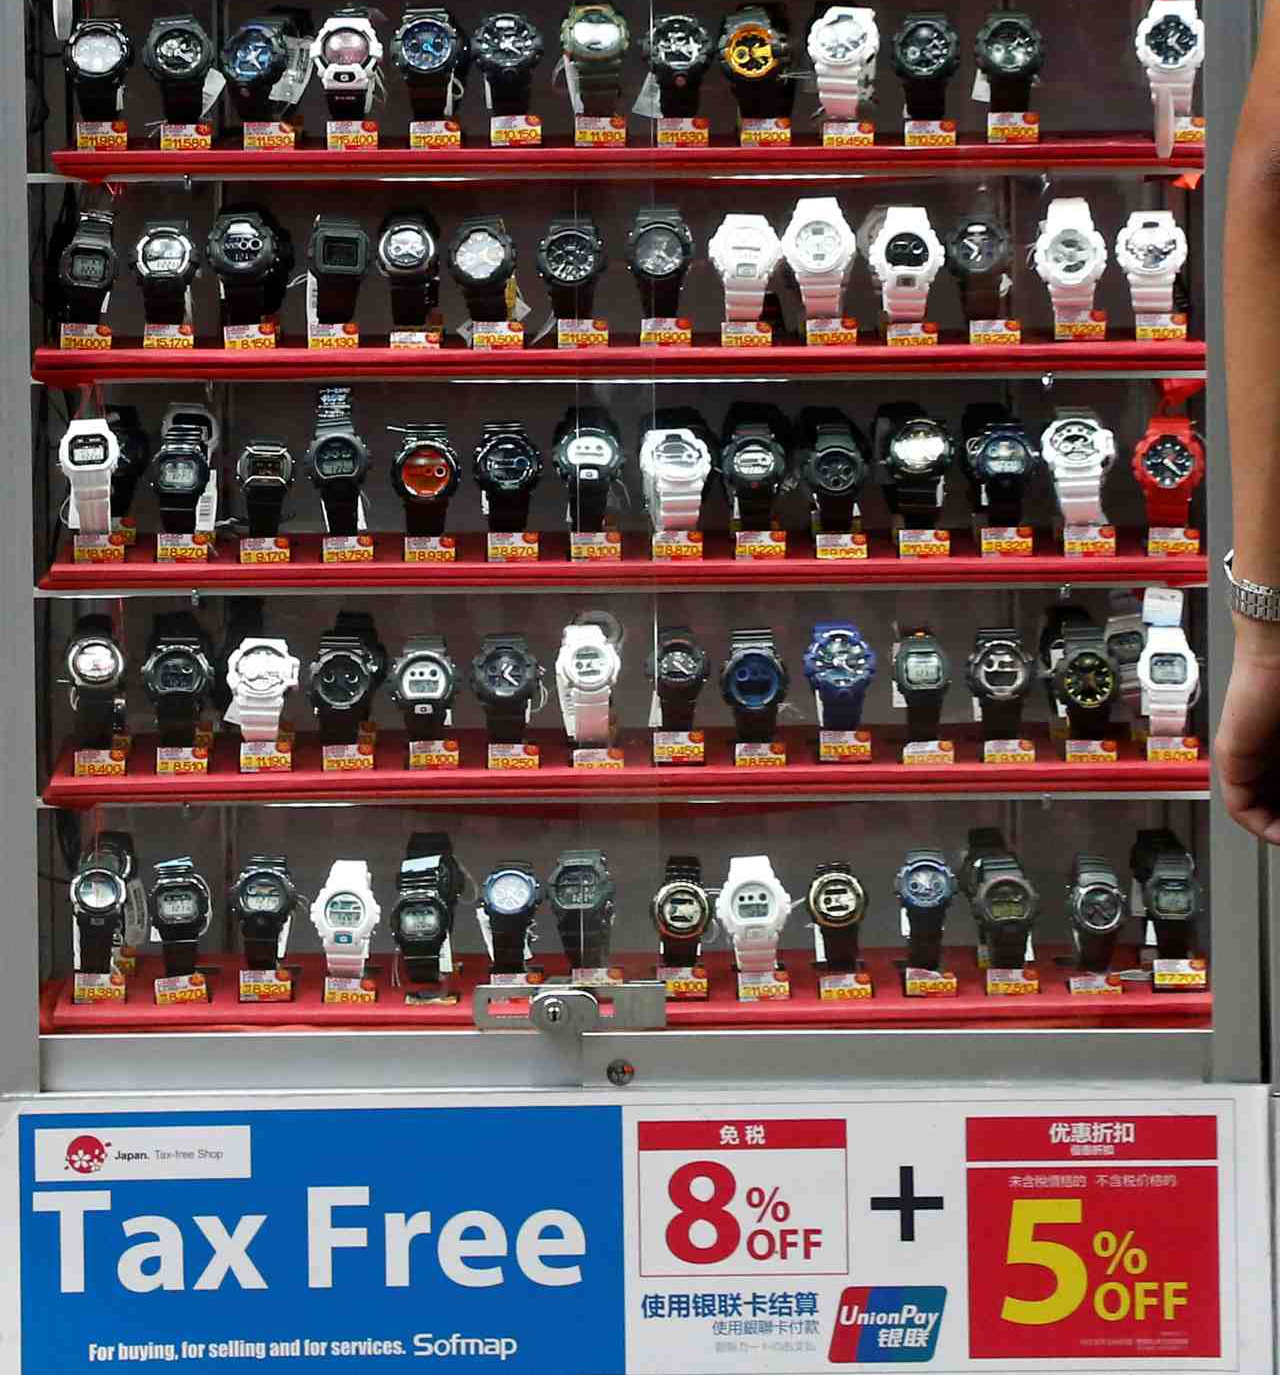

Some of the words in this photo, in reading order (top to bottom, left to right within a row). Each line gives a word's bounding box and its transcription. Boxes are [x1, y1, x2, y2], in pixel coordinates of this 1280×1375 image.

[719, 1124, 766, 1145] 免税
[1048, 1121, 1135, 1144] 优惠折扣
[197, 1148, 224, 1160] Shop
[664, 1160, 742, 1265] 8
[32, 1189, 269, 1294] Tax
[306, 1185, 586, 1289] Free
[746, 1228, 823, 1261] OFF
[1000, 1197, 1089, 1326] 5
[640, 1291, 820, 1319] 使用银联卡结算
[1092, 1281, 1189, 1322] OFF
[840, 1304, 939, 1332] UnionPay
[88, 1343, 115, 1362] For
[117, 1341, 179, 1362] buying,
[181, 1341, 206, 1359] for
[208, 1339, 266, 1360] selling
[269, 1338, 301, 1357] and
[303, 1338, 328, 1357] for
[330, 1337, 407, 1356] services.
[413, 1333, 518, 1361] Sofmap
[877, 1328, 929, 1348] 银联
